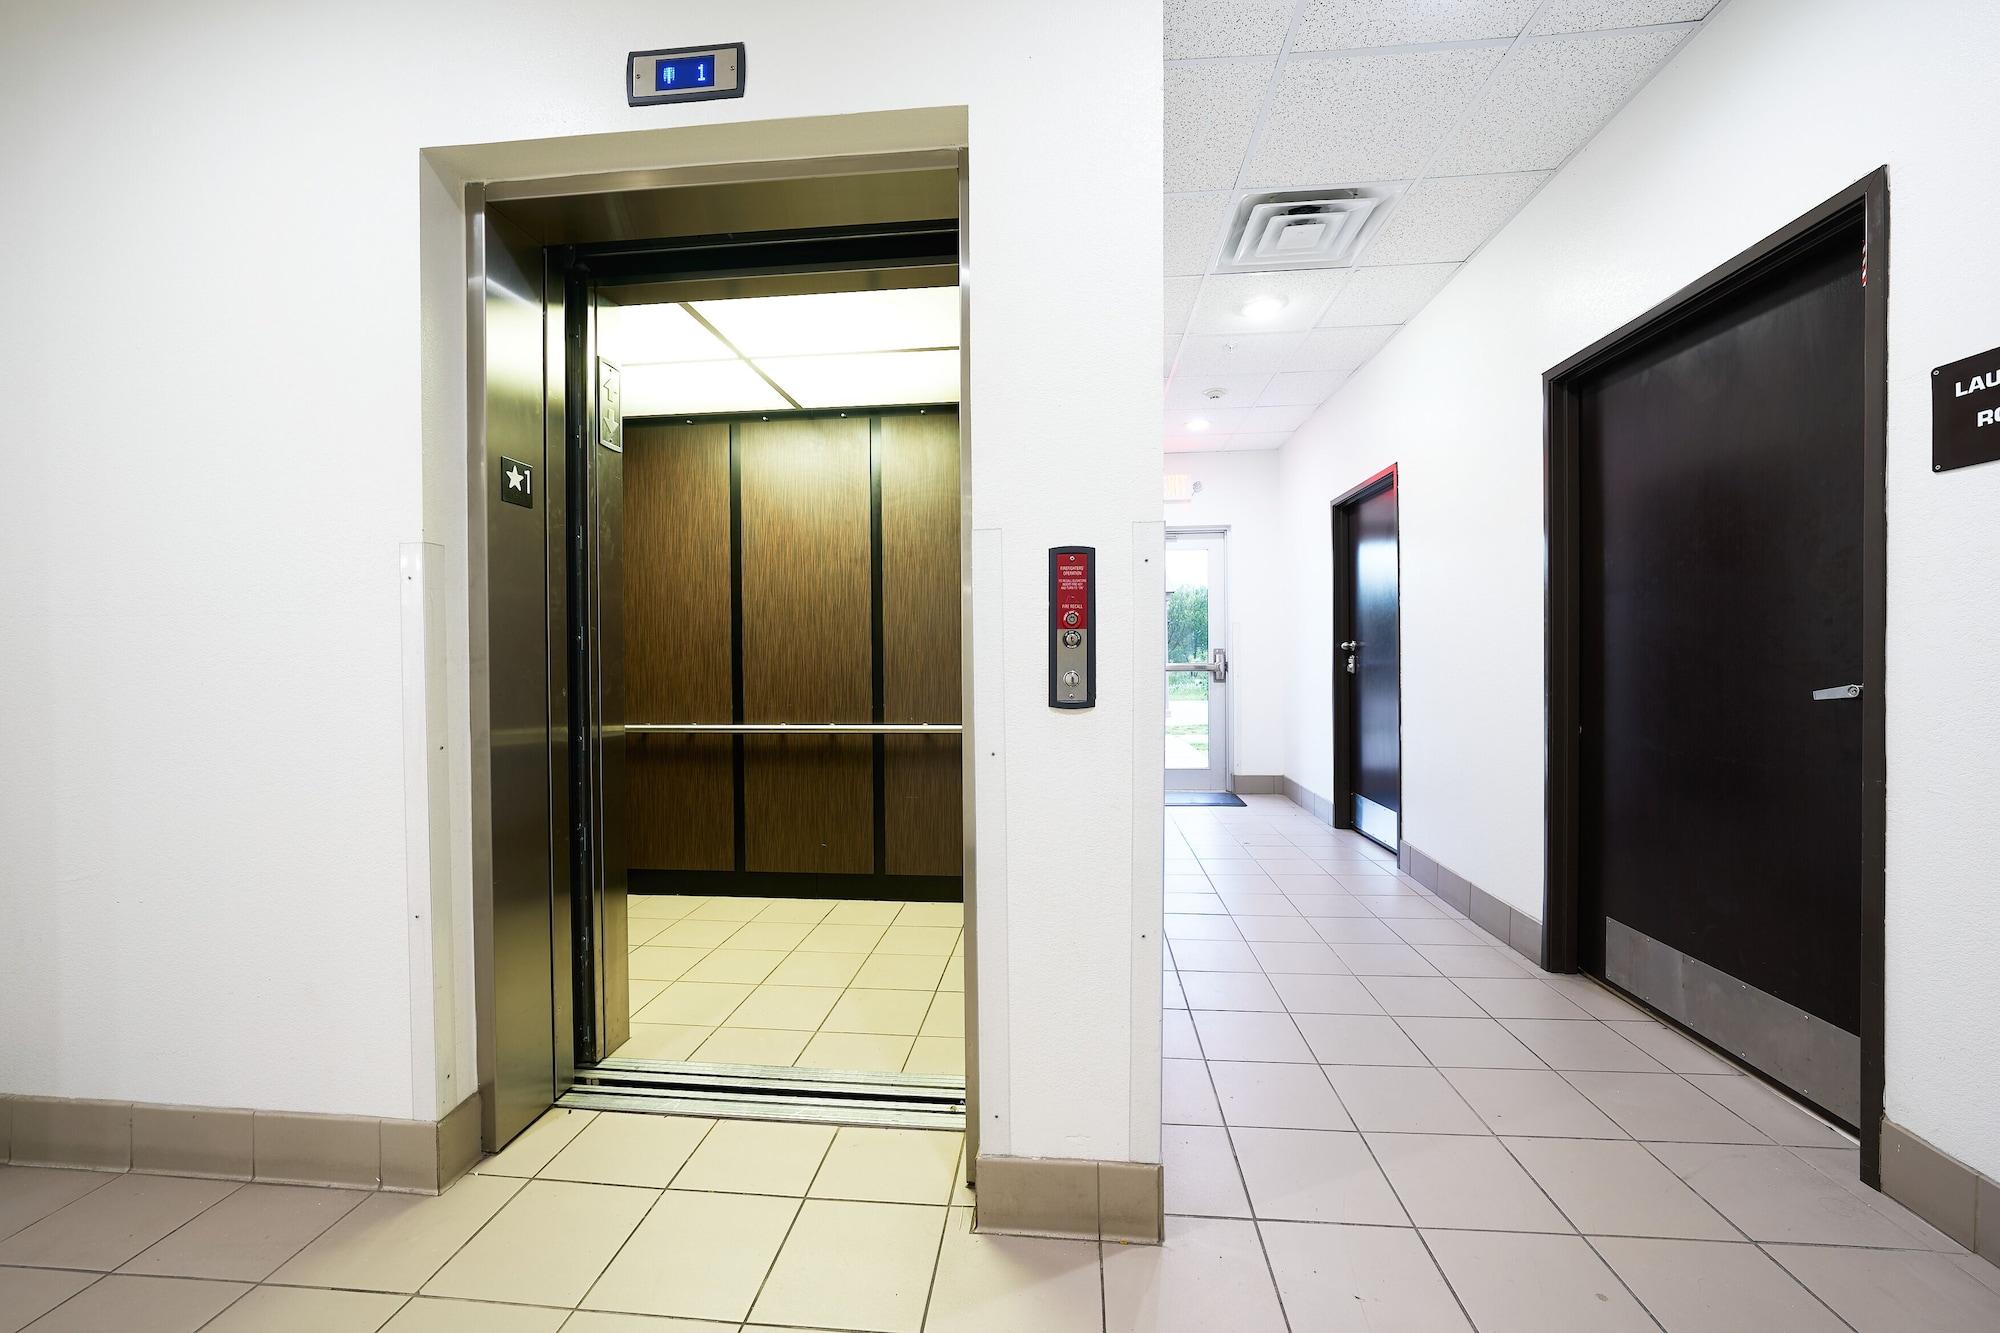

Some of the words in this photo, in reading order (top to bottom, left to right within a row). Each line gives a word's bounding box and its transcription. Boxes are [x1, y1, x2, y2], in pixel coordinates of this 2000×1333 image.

[697, 63, 706, 81] 1
[1955, 369, 2000, 398] LAU
[524, 469, 531, 494] 1
